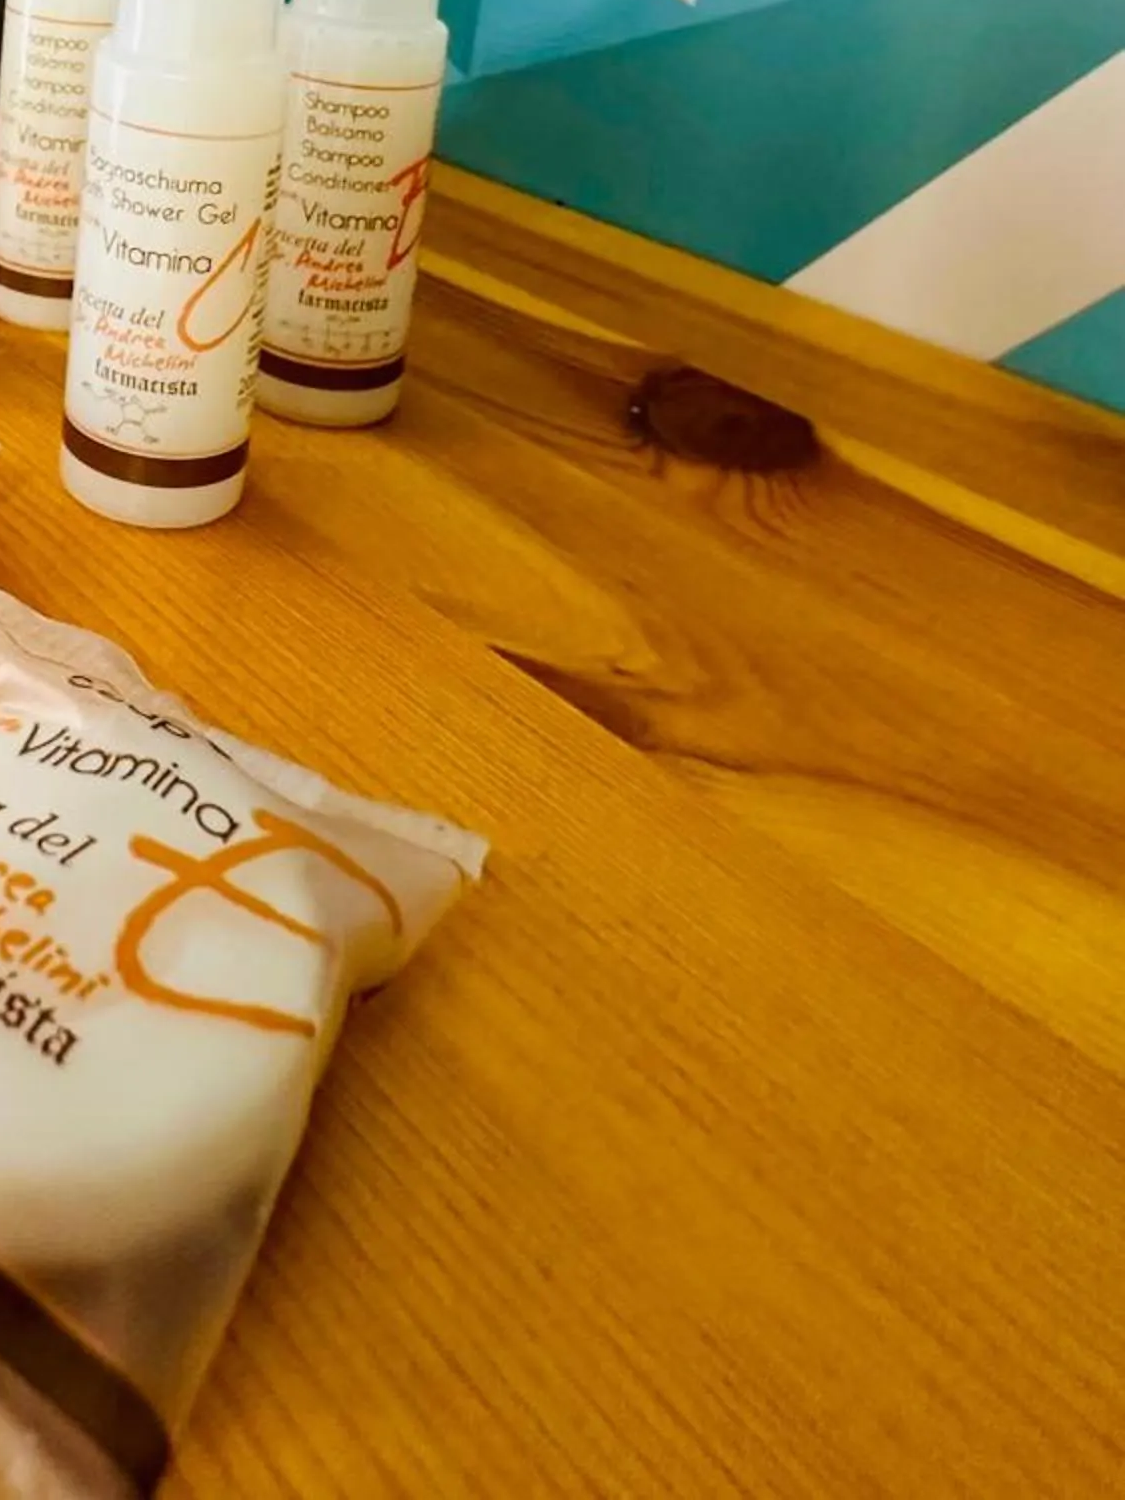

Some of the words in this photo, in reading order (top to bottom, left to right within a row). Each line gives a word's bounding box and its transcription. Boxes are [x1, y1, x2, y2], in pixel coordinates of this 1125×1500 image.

[302, 92, 390, 124] Shampoo
[306, 115, 385, 143] Balsamo
[301, 139, 385, 171] Shampoo
[107, 186, 186, 223] Shower
[197, 202, 239, 226] Gel
[302, 198, 400, 232] Vitamina
[97, 226, 213, 275] Vitamina
[333, 238, 366, 259] del
[298, 288, 390, 314] farmacista
[129, 306, 165, 330] del
[93, 358, 200, 397] farmacista
[17, 722, 241, 844] Vitamina
[7, 811, 98, 867] del
